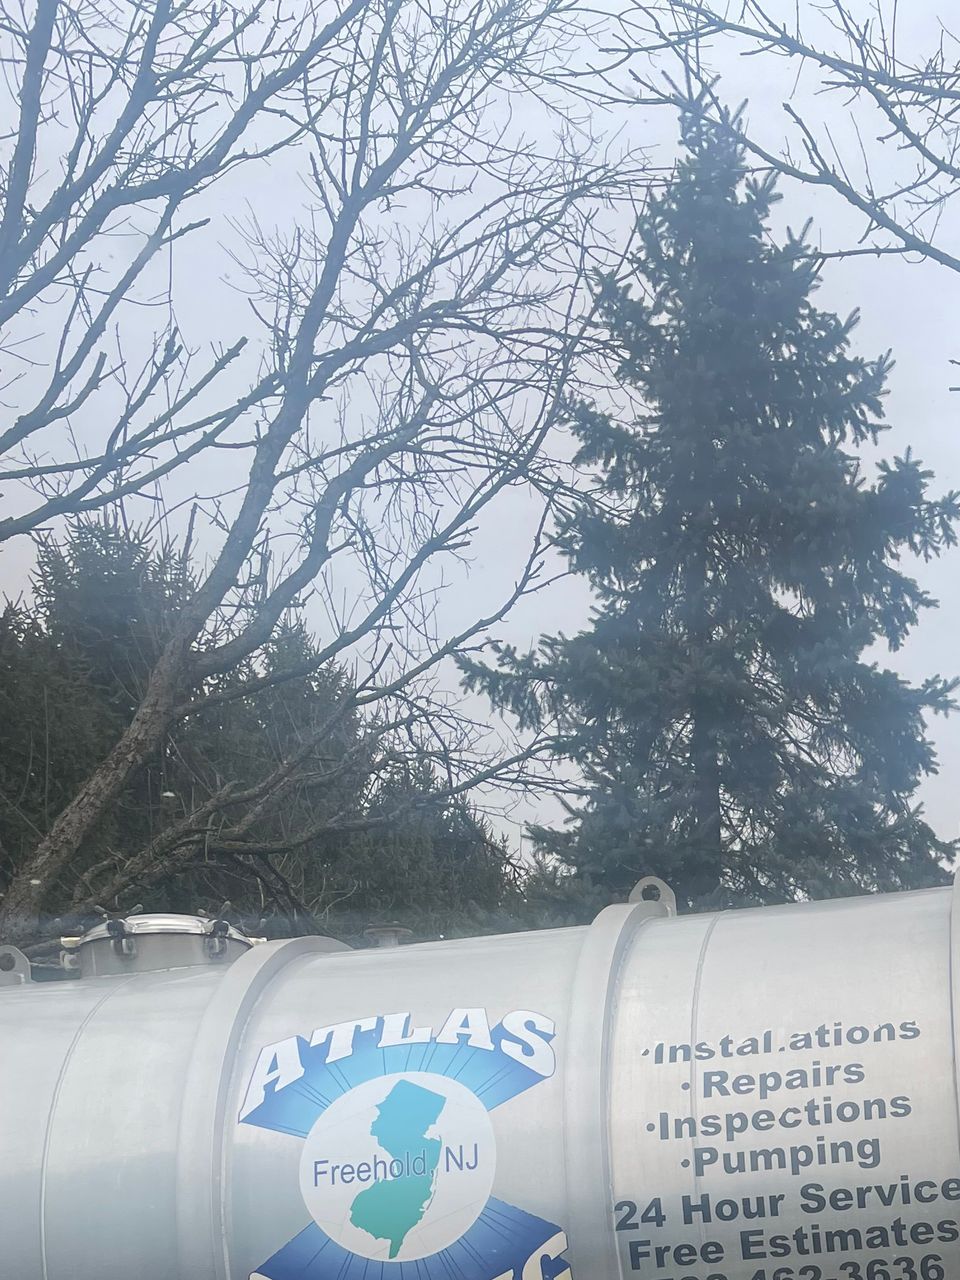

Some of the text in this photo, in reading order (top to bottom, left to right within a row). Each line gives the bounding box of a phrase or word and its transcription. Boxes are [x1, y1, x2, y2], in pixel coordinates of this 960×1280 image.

[654, 1019, 921, 1065] Instalations
[238, 1007, 557, 1123] ATLAS
[703, 1060, 866, 1100] Repairs
[659, 1095, 913, 1142] Inspections
[312, 1143, 479, 1188] Freehold, NJ
[694, 1136, 882, 1177] Pumping
[614, 1197, 667, 1232] 24
[682, 1192, 785, 1225] Hour
[628, 1217, 960, 1271] Free Estimates
